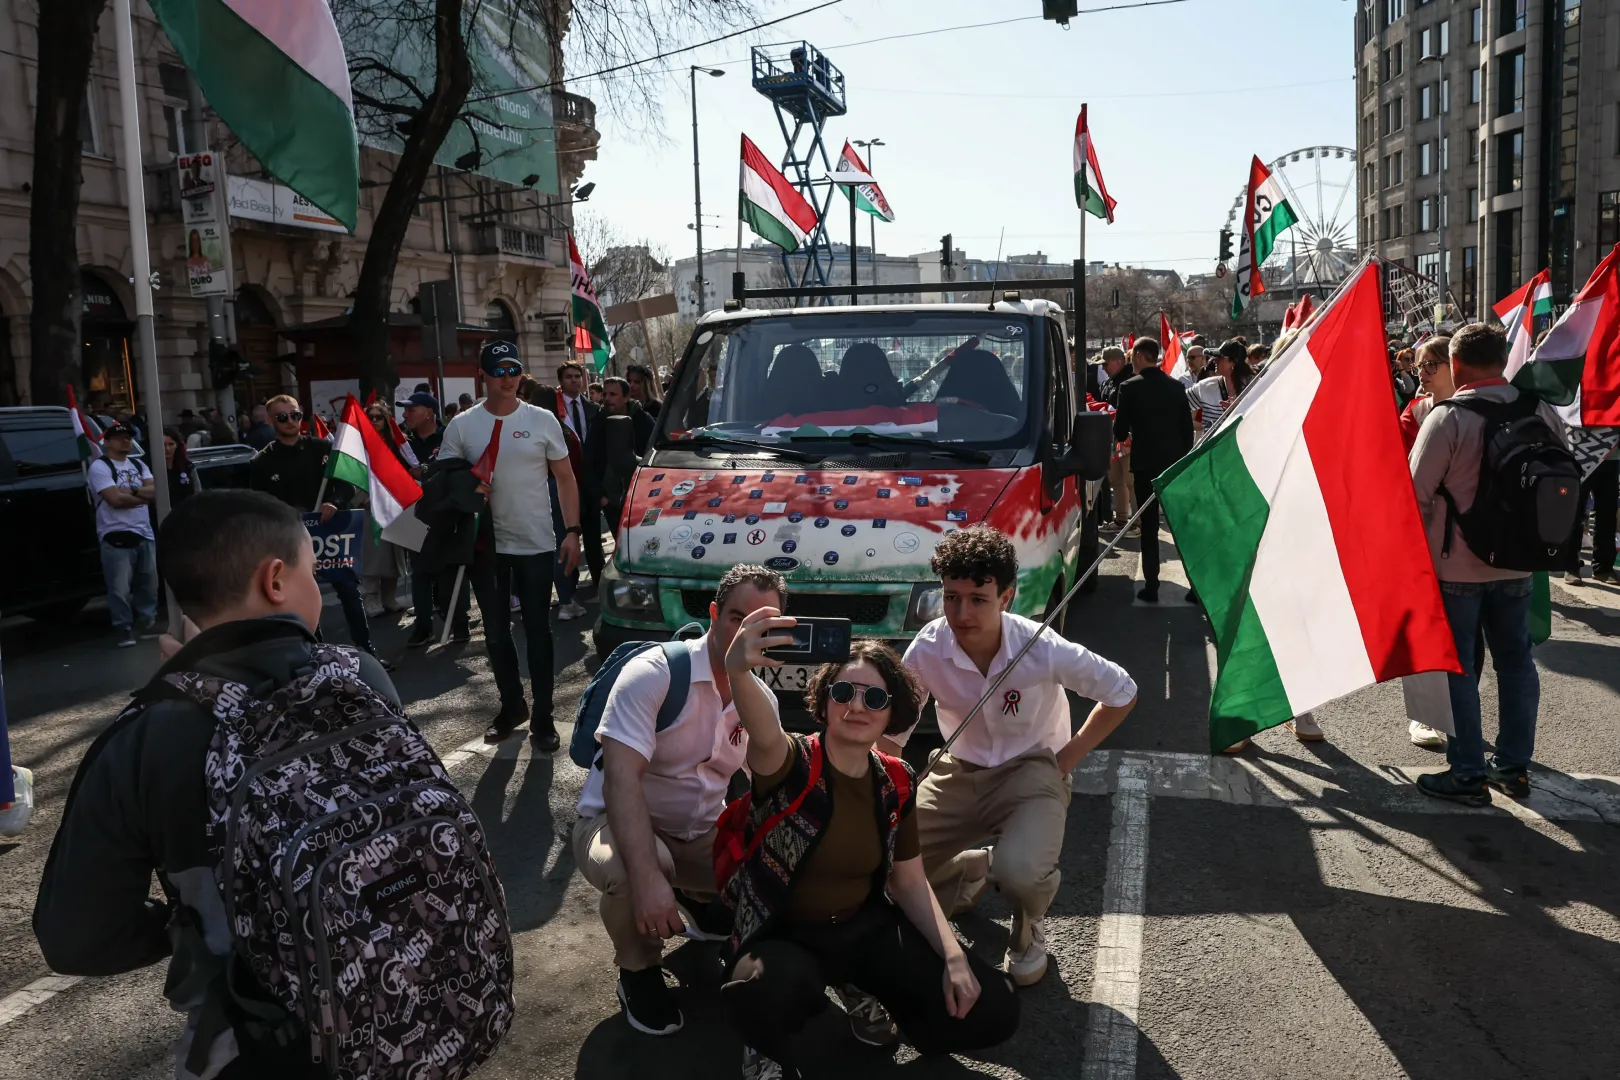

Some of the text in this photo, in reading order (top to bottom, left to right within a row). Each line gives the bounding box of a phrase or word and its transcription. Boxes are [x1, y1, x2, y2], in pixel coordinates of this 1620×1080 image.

[250, 199, 284, 217] Beauty
[311, 533, 356, 558] OST
[772, 558, 793, 568] Ford
[351, 739, 379, 757] SCIENCE
[306, 791, 328, 808] SKATE
[305, 819, 365, 852] SCHOOL
[376, 874, 417, 901] AOKING
[428, 895, 450, 914] SKATE
[419, 971, 478, 1006] SCHOOL
[404, 991, 418, 1020] SCIENCE
[460, 995, 479, 1012] SKATE
[401, 1025, 424, 1043] PHYSICS
